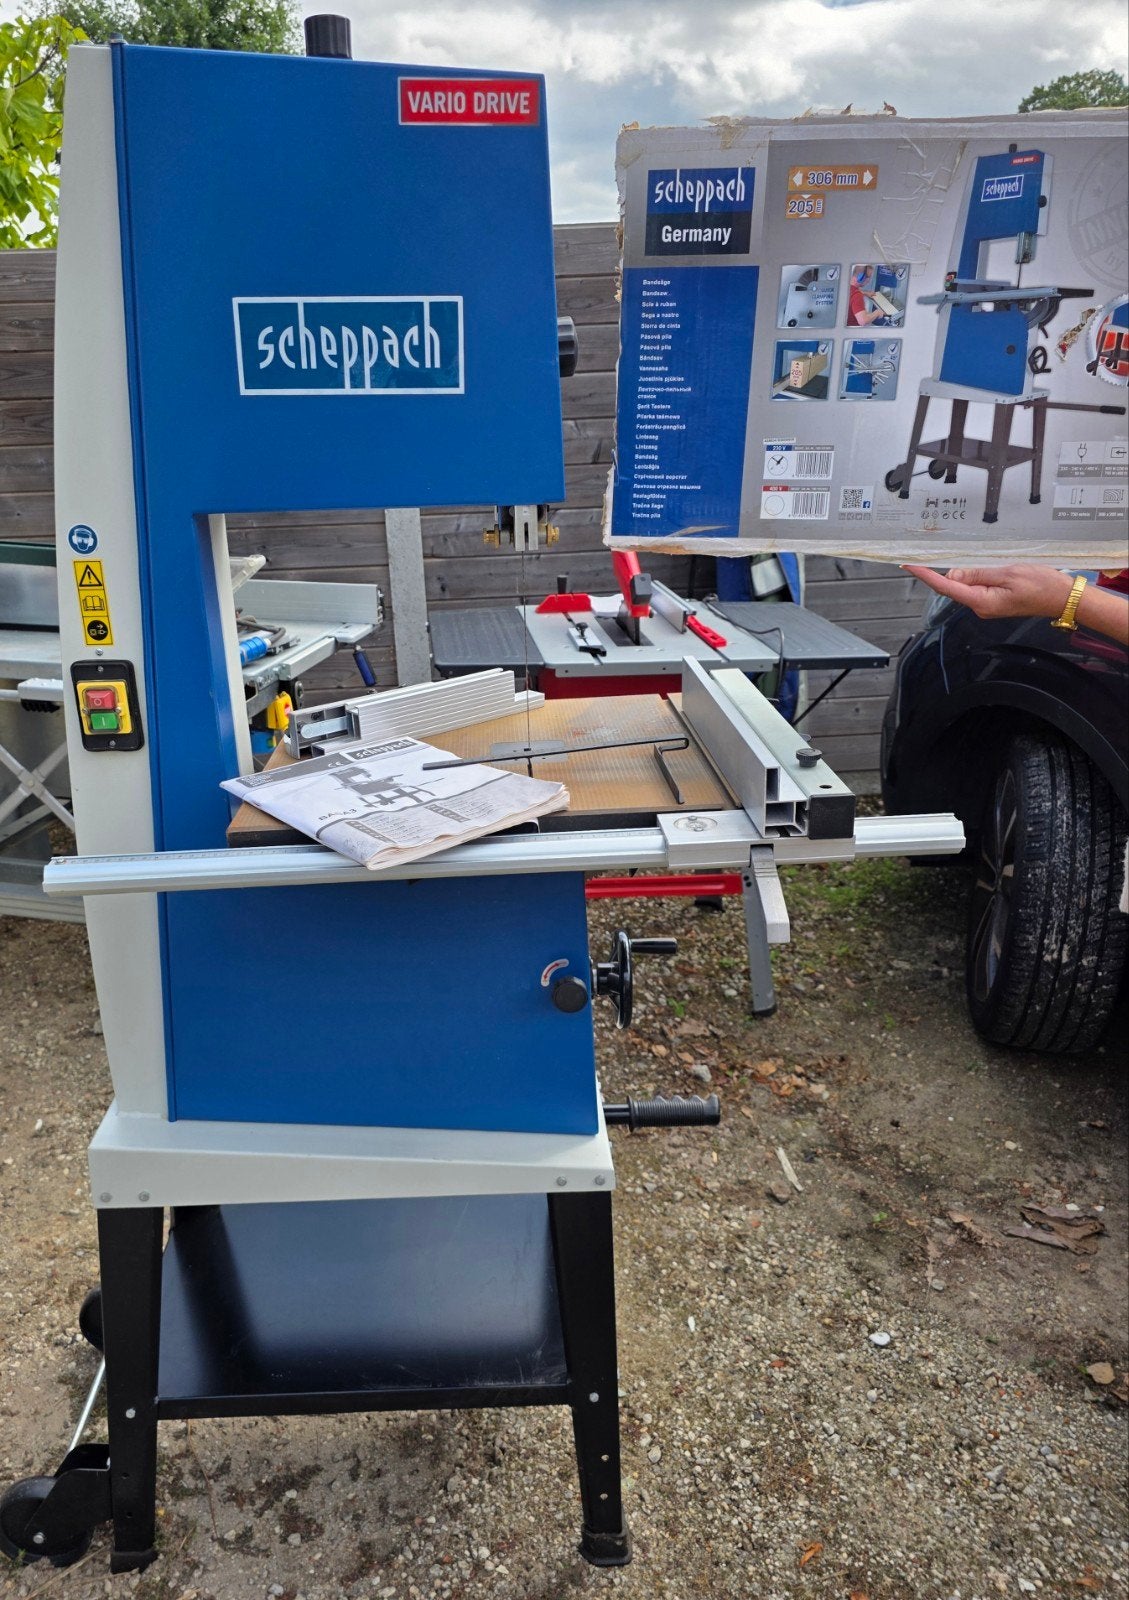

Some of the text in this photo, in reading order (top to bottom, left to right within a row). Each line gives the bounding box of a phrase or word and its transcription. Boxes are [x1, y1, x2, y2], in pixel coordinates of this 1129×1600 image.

[408, 91, 530, 114] VARIO DRIVE
[808, 171, 859, 186] 306 mm
[985, 175, 1020, 199] scheppach
[654, 168, 745, 213] scheppach
[789, 200, 814, 214] 205
[661, 225, 732, 246] Germany
[257, 300, 441, 389] scheppach
